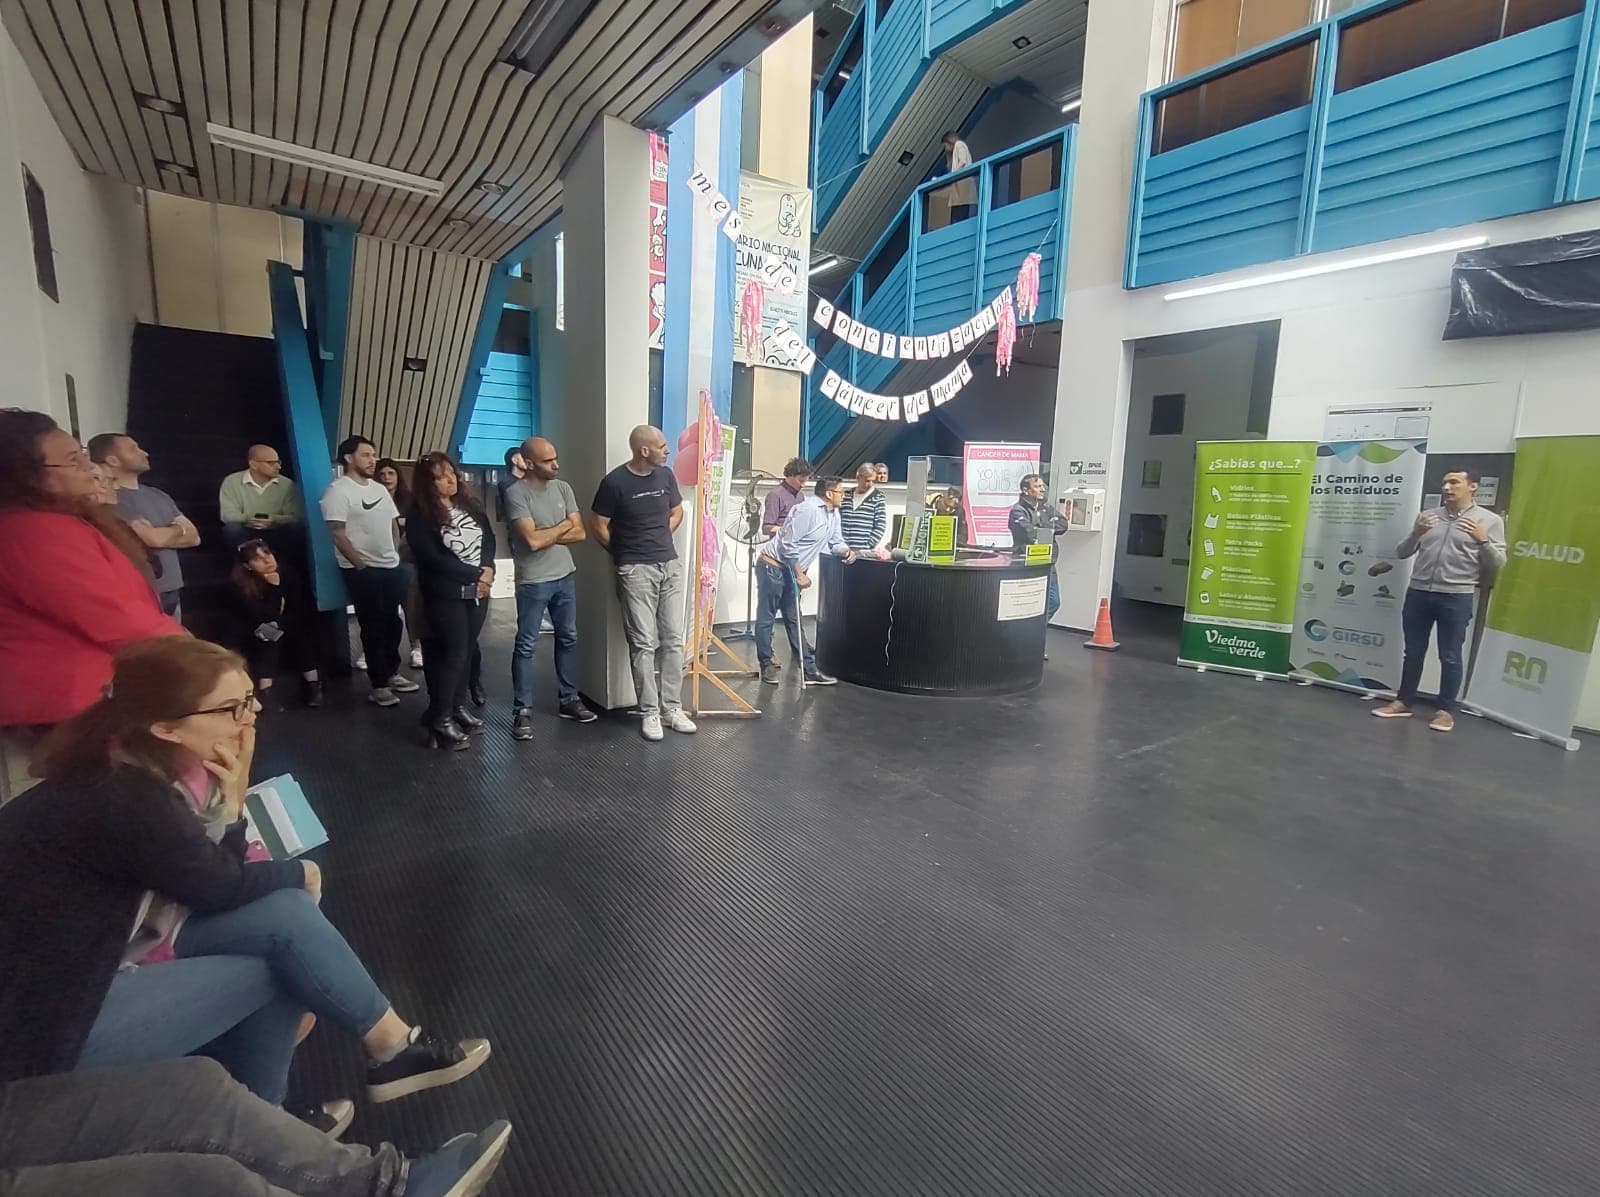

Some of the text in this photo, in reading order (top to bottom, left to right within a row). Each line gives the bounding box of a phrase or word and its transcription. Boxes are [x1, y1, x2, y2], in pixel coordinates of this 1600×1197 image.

[693, 171, 741, 229] mes
[765, 264, 792, 287] de
[762, 241, 801, 261] NACIONAL
[774, 326, 811, 364] del
[906, 392, 926, 415] de
[1209, 459, 1255, 470] ¿Sabías
[1312, 474, 1403, 484] El Camino de
[1311, 486, 1399, 495] los Residuos
[1514, 541, 1584, 564] SALUD
[1205, 629, 1256, 648] Viedma
[1333, 630, 1384, 648] GIRSU
[1229, 646, 1266, 659] verde
